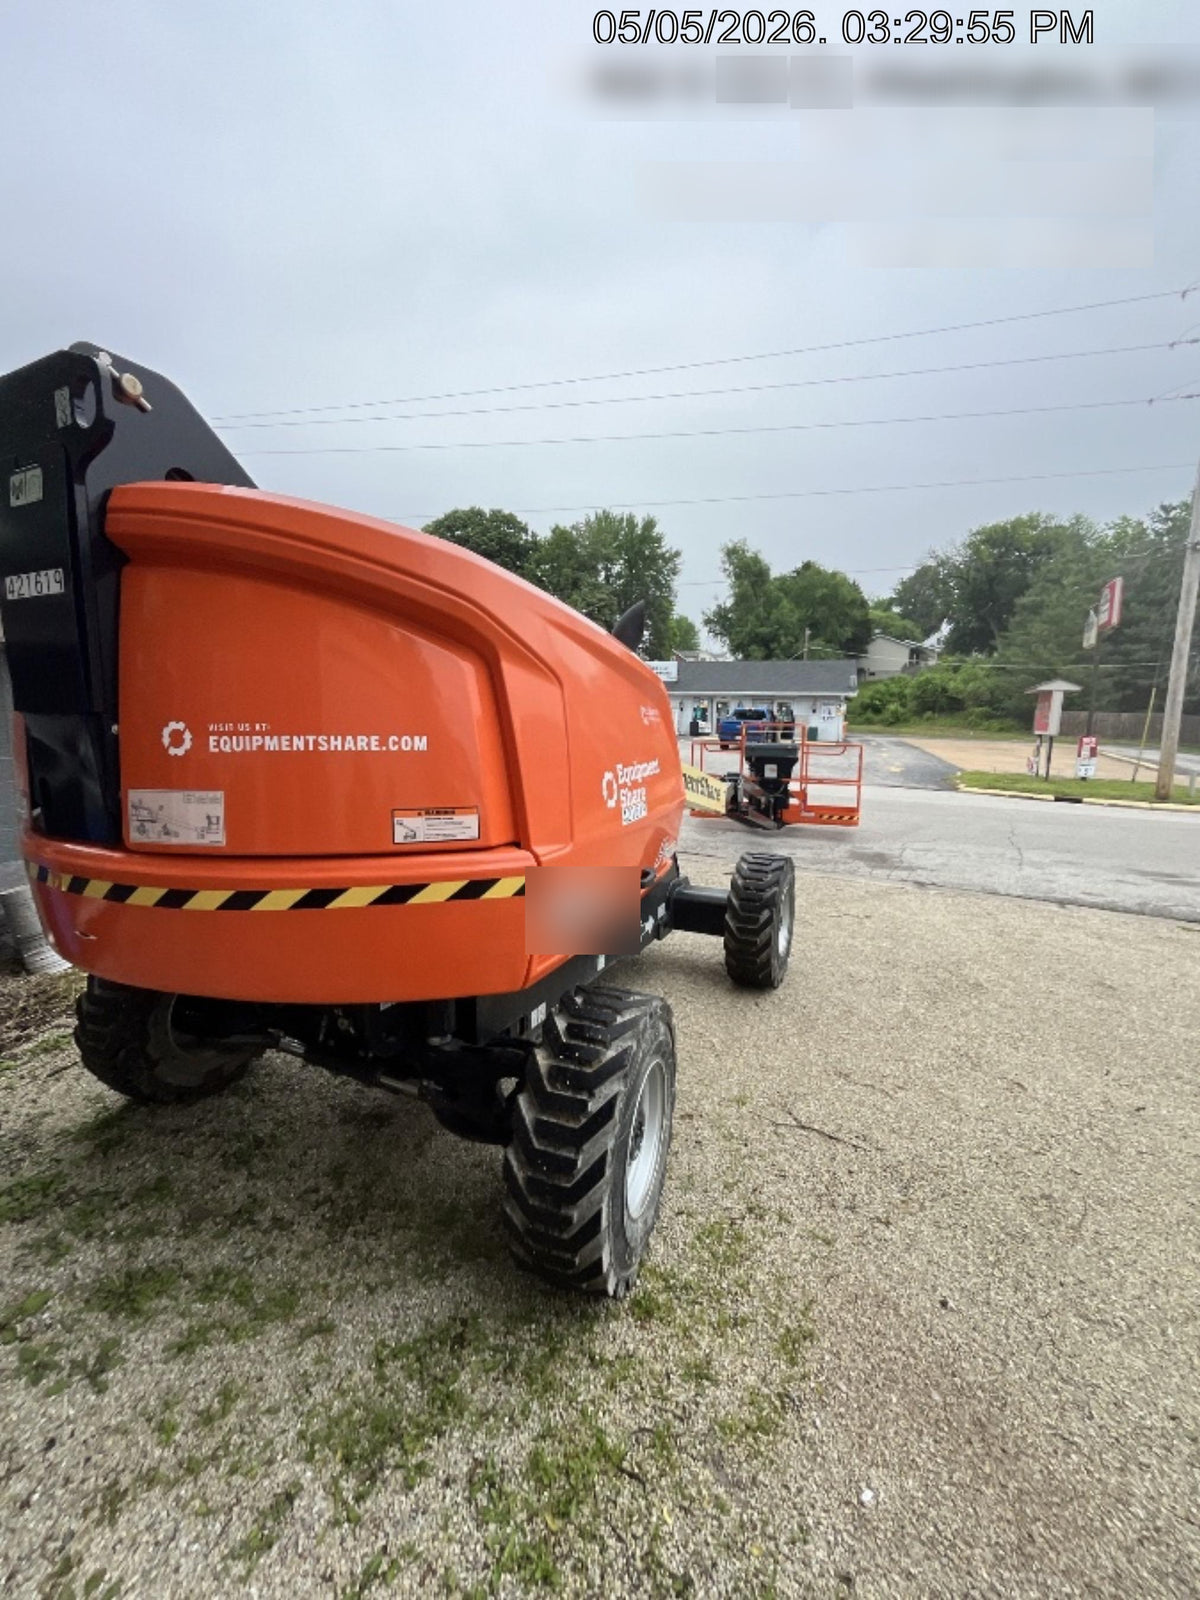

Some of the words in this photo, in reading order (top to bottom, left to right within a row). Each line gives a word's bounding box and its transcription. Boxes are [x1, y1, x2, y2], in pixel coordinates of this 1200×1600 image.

[8, 569, 63, 598] 421619
[208, 723, 234, 732] VISIT
[238, 723, 250, 732] US
[208, 735, 428, 753] EQUIPMENTSHARE.COM
